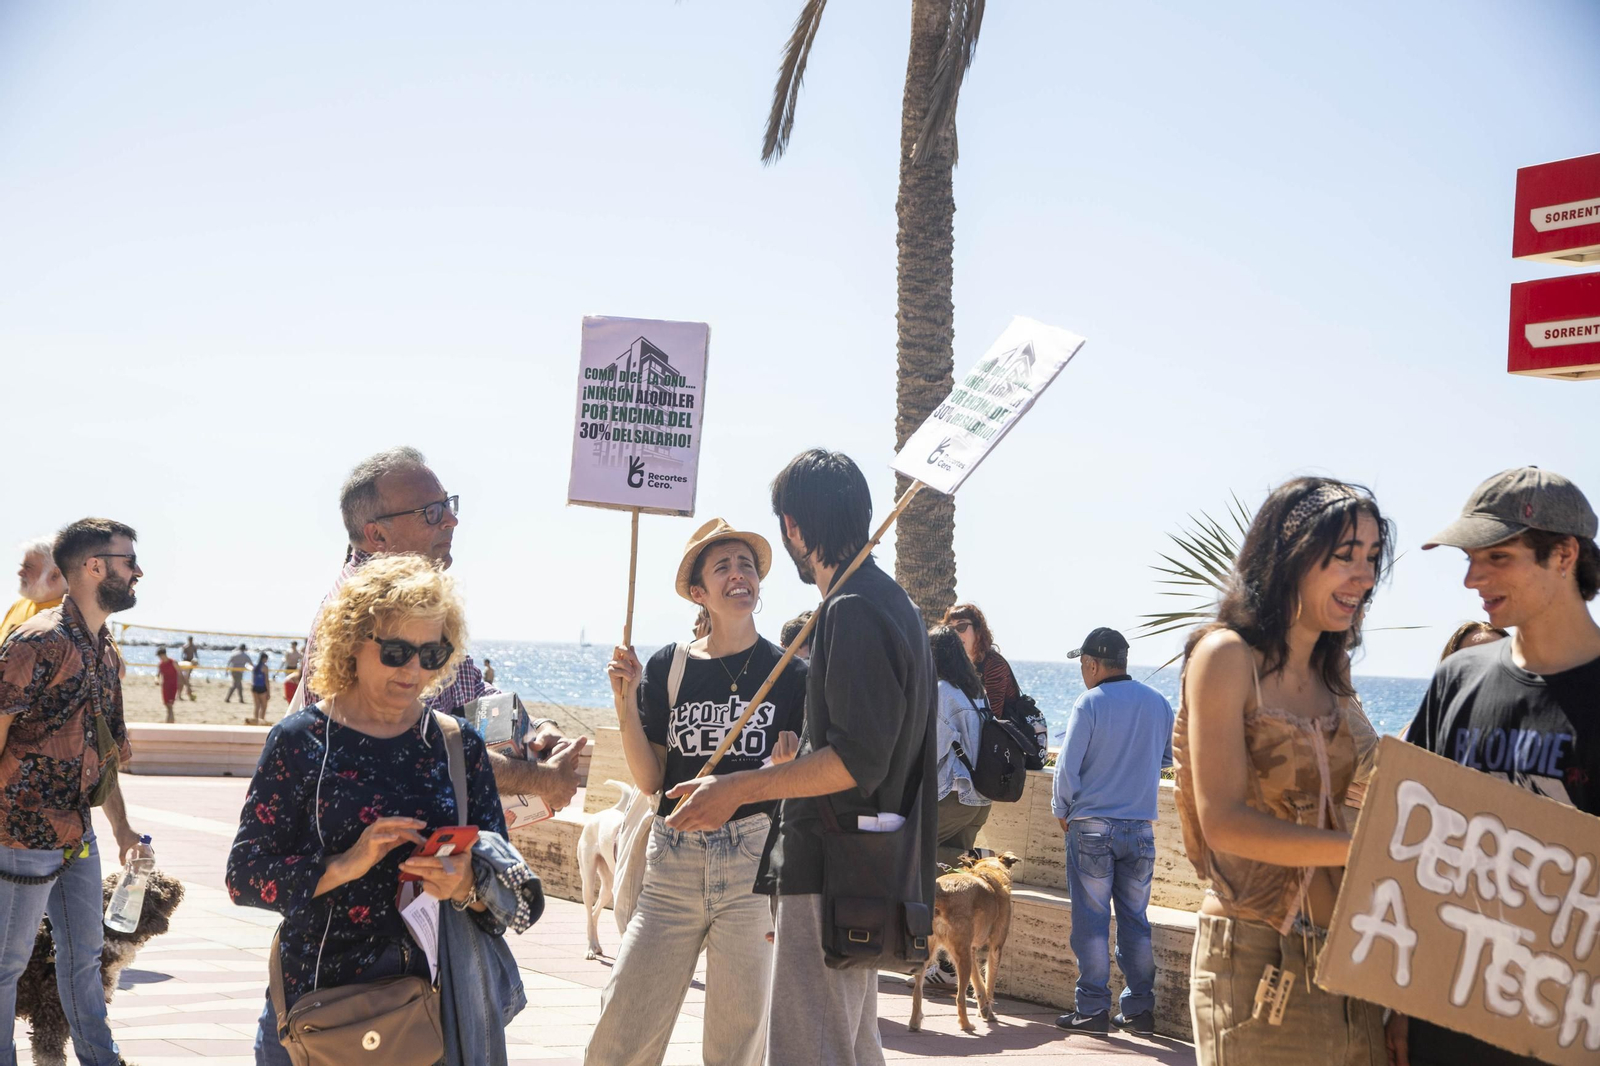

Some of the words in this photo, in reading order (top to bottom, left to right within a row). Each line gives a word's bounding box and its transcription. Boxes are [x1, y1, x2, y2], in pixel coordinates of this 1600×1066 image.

[584, 367, 615, 382] COMO
[619, 370, 643, 384] DICE
[647, 372, 659, 385] LA
[636, 390, 694, 409] ALQUILER
[581, 402, 609, 421] POR
[612, 405, 665, 427] ENCIMA
[668, 411, 693, 429] DEL
[579, 421, 611, 441] 30%
[647, 480, 673, 490] Cero.
[648, 472, 688, 483] Recortes
[1454, 727, 1573, 778] BLONDIE
[1351, 879, 1418, 987] A
